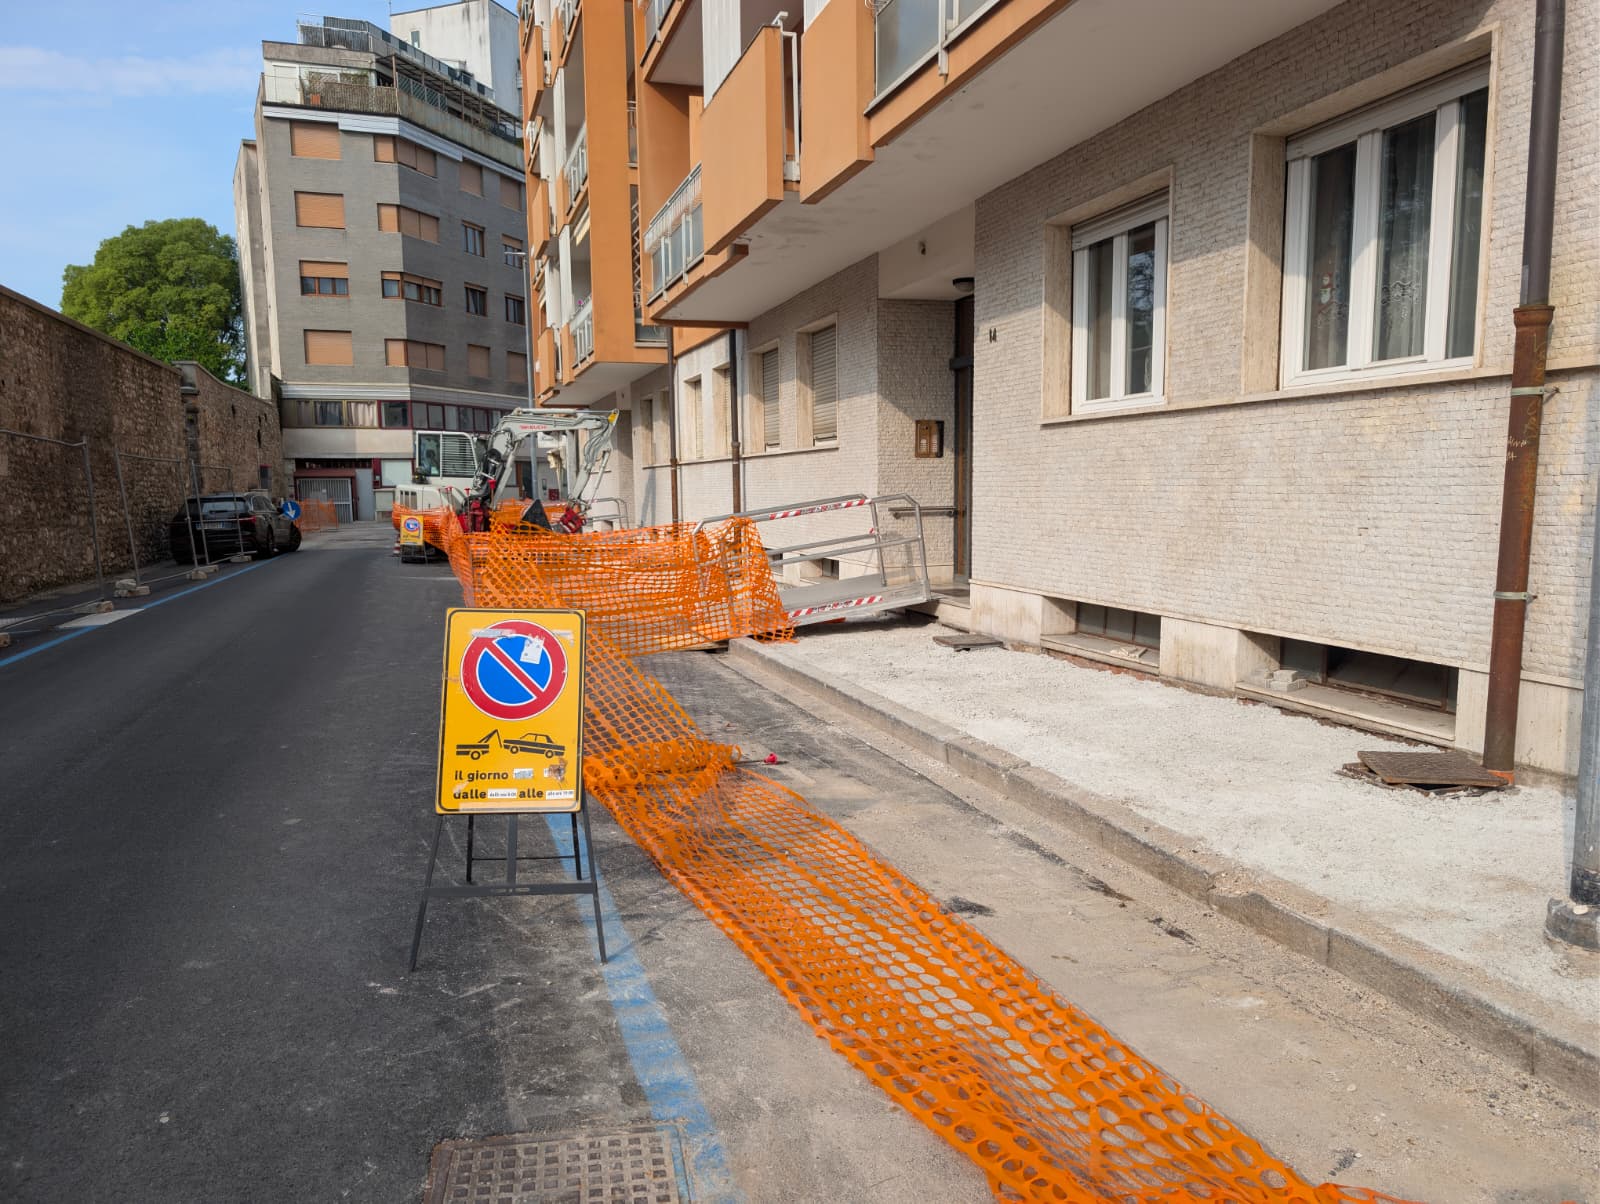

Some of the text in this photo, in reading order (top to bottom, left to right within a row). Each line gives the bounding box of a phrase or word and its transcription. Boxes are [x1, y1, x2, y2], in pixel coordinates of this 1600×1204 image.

[989, 327, 997, 344] 14
[454, 770, 463, 781] il
[467, 770, 509, 782] giorno
[453, 788, 487, 800] dalle
[518, 788, 544, 799] alle
